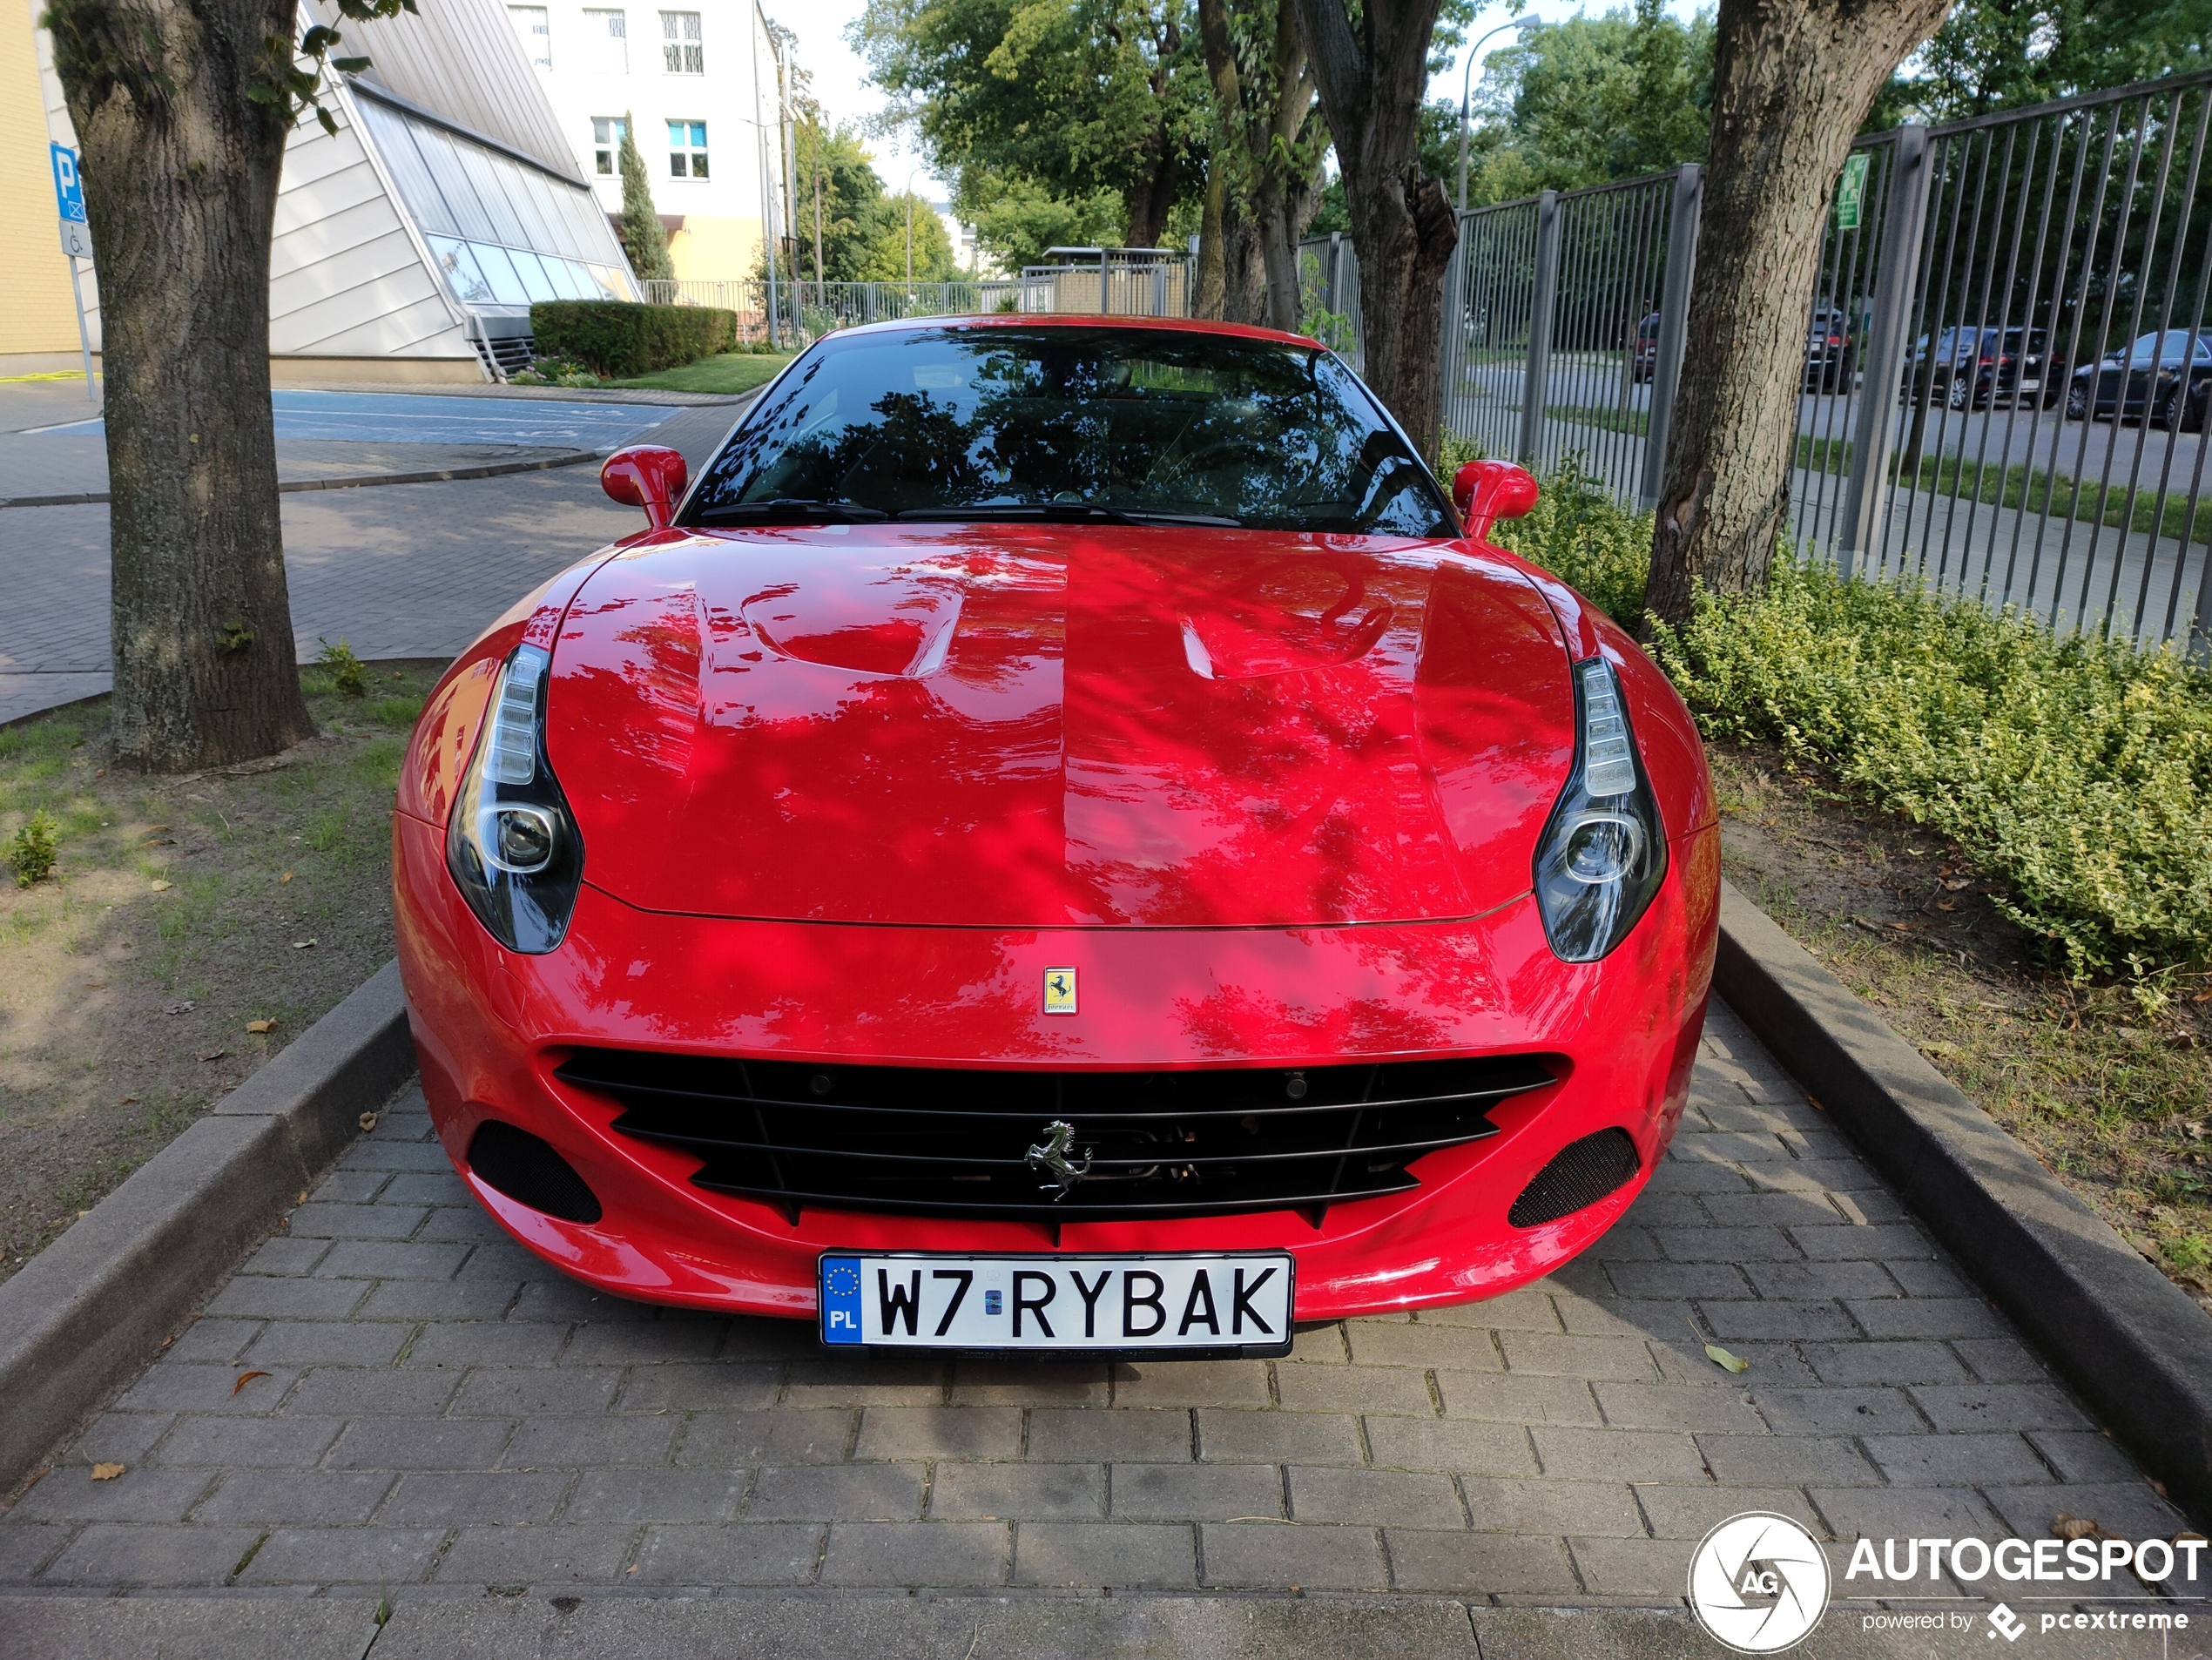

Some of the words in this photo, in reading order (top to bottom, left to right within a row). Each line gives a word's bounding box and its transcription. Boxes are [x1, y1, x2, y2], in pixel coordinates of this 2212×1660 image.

[56, 152, 75, 198] P
[830, 1311, 857, 1329] PL
[877, 1268, 973, 1336] W7
[1013, 1267, 1278, 1338] RYBAK
